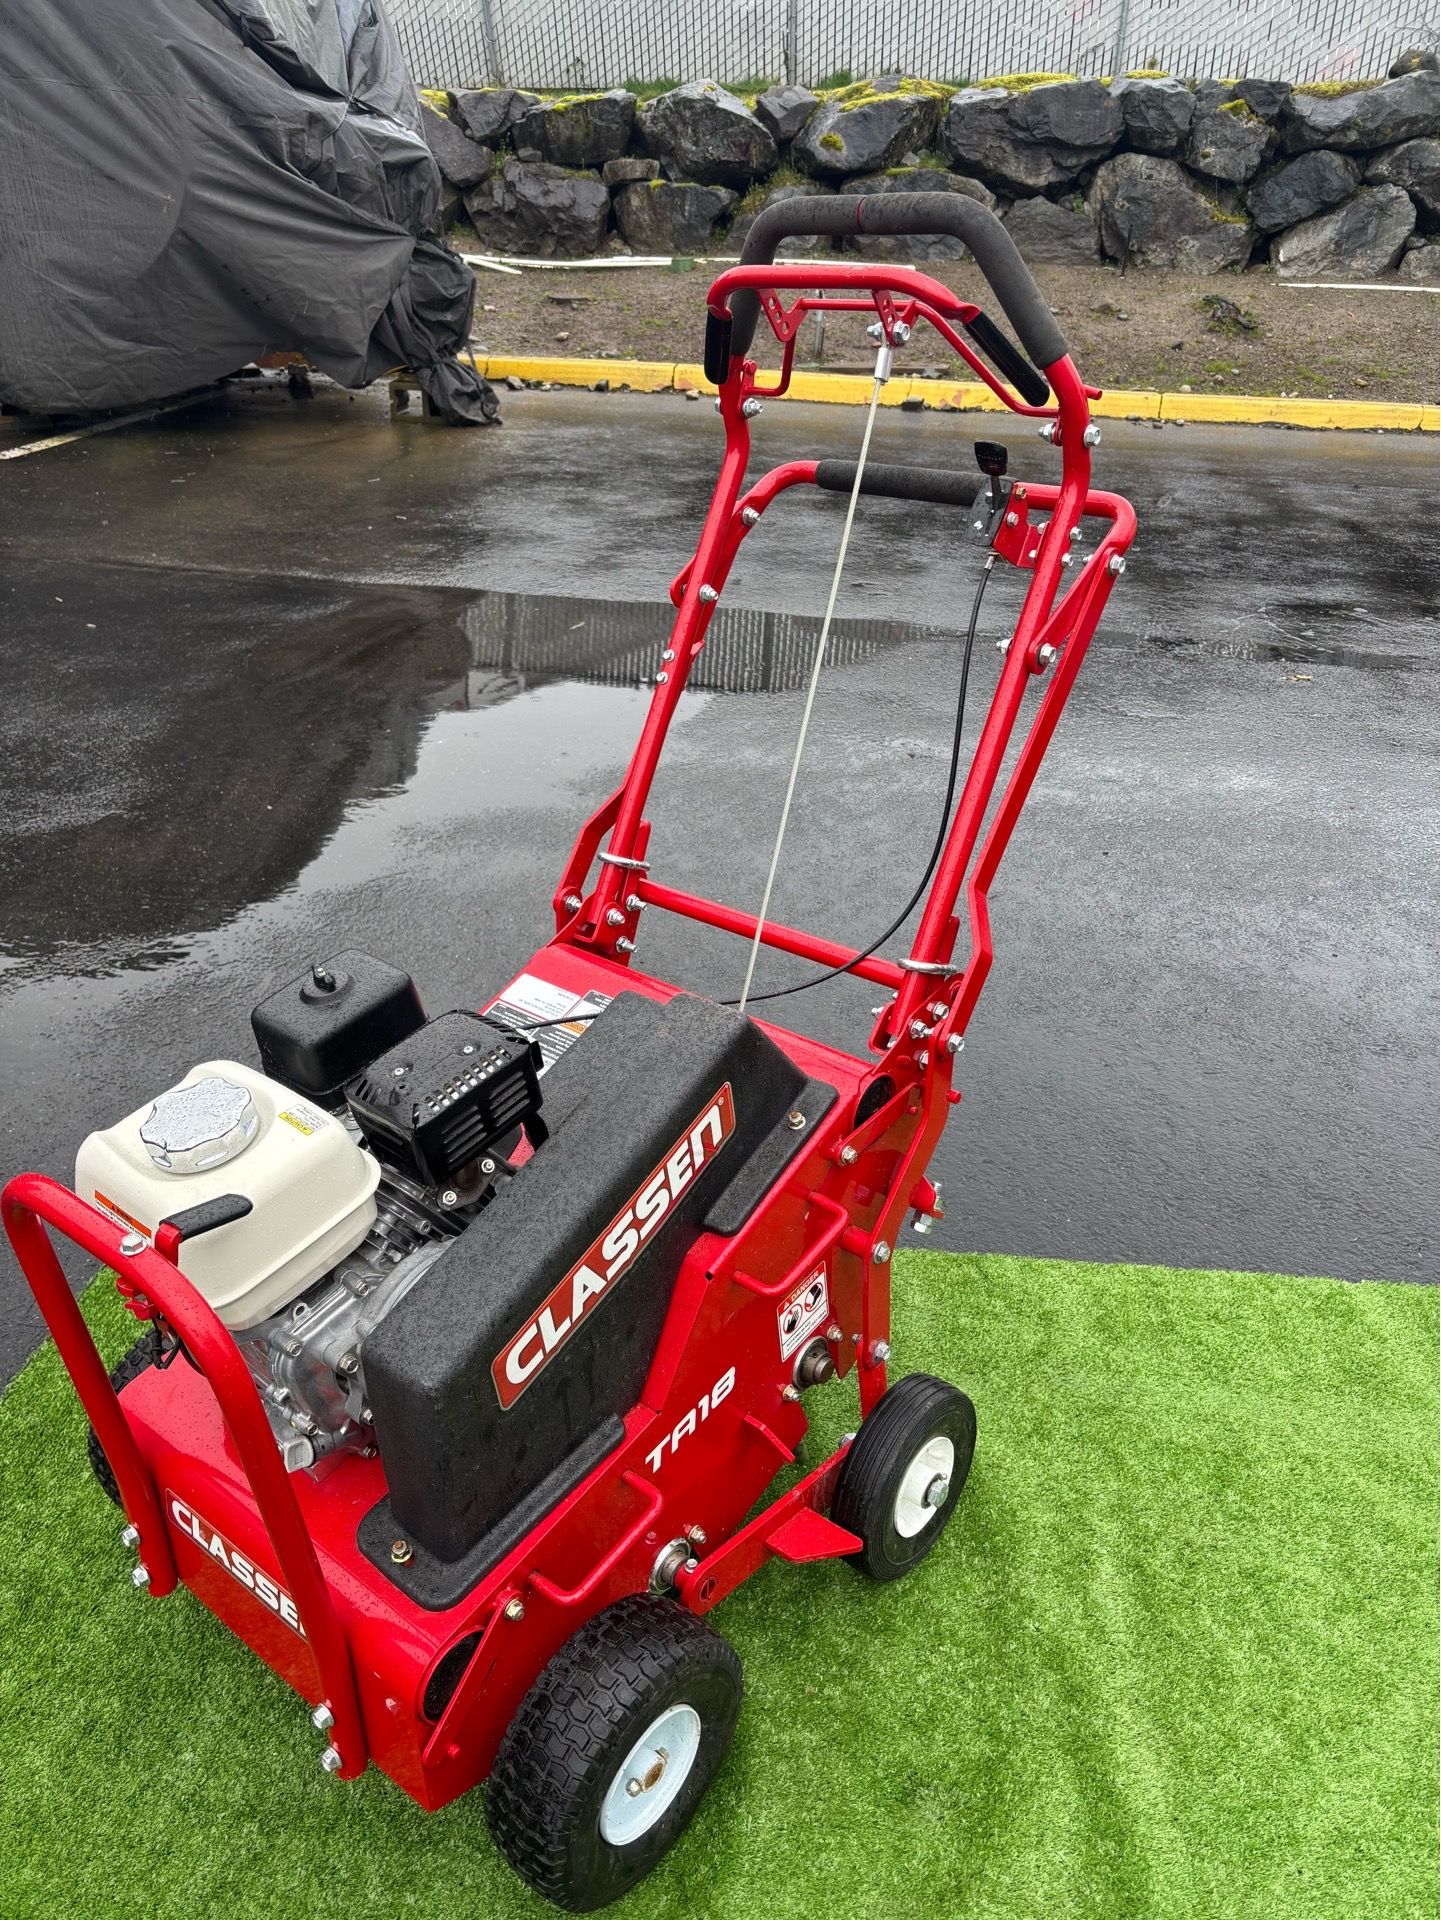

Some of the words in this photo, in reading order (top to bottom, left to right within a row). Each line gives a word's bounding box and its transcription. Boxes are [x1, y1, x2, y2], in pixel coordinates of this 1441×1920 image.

[791, 1270, 820, 1303] DANGER
[644, 1366, 736, 1474] TA18
[171, 1500, 307, 1637] CLASSE
